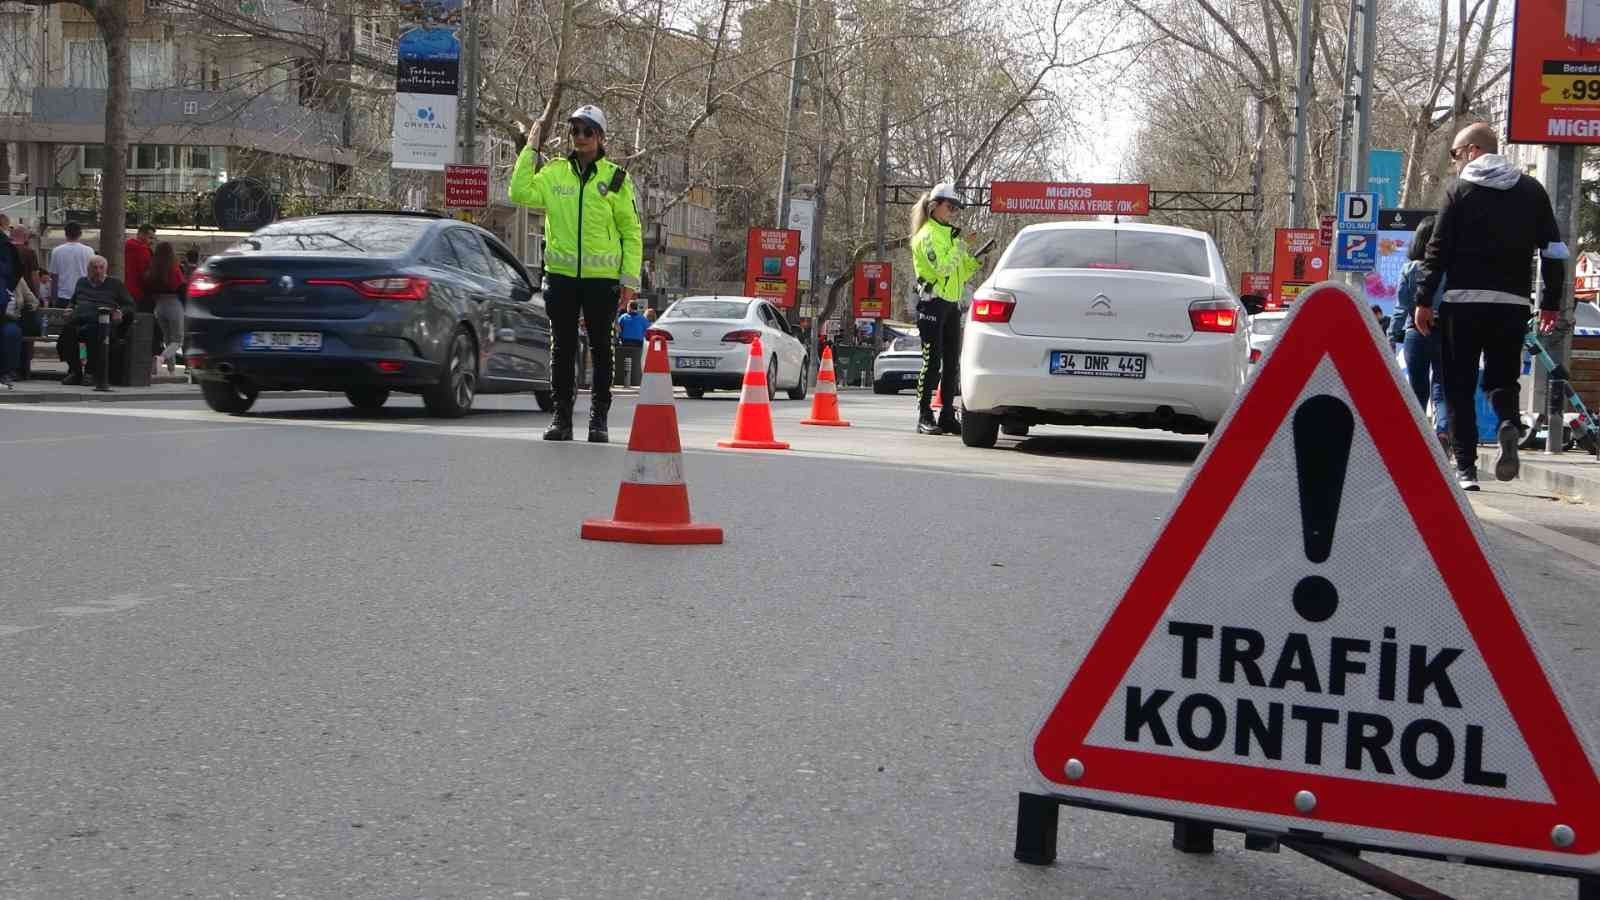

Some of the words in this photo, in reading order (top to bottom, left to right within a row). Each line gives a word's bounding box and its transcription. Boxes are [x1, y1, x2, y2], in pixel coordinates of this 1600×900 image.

[1563, 63, 1597, 73] Bereket
[1007, 198, 1018, 209] BU
[1020, 198, 1056, 210] UCUZLUK
[1058, 199, 1086, 212] BAŞKA
[1088, 200, 1113, 211] YERDE
[1348, 197, 1368, 219] D
[1061, 354, 1076, 369] 34
[1085, 356, 1109, 370] DNR
[1119, 358, 1143, 372] 449
[1168, 621, 1464, 708] TRAFİK
[1124, 686, 1507, 788] KONTROL
